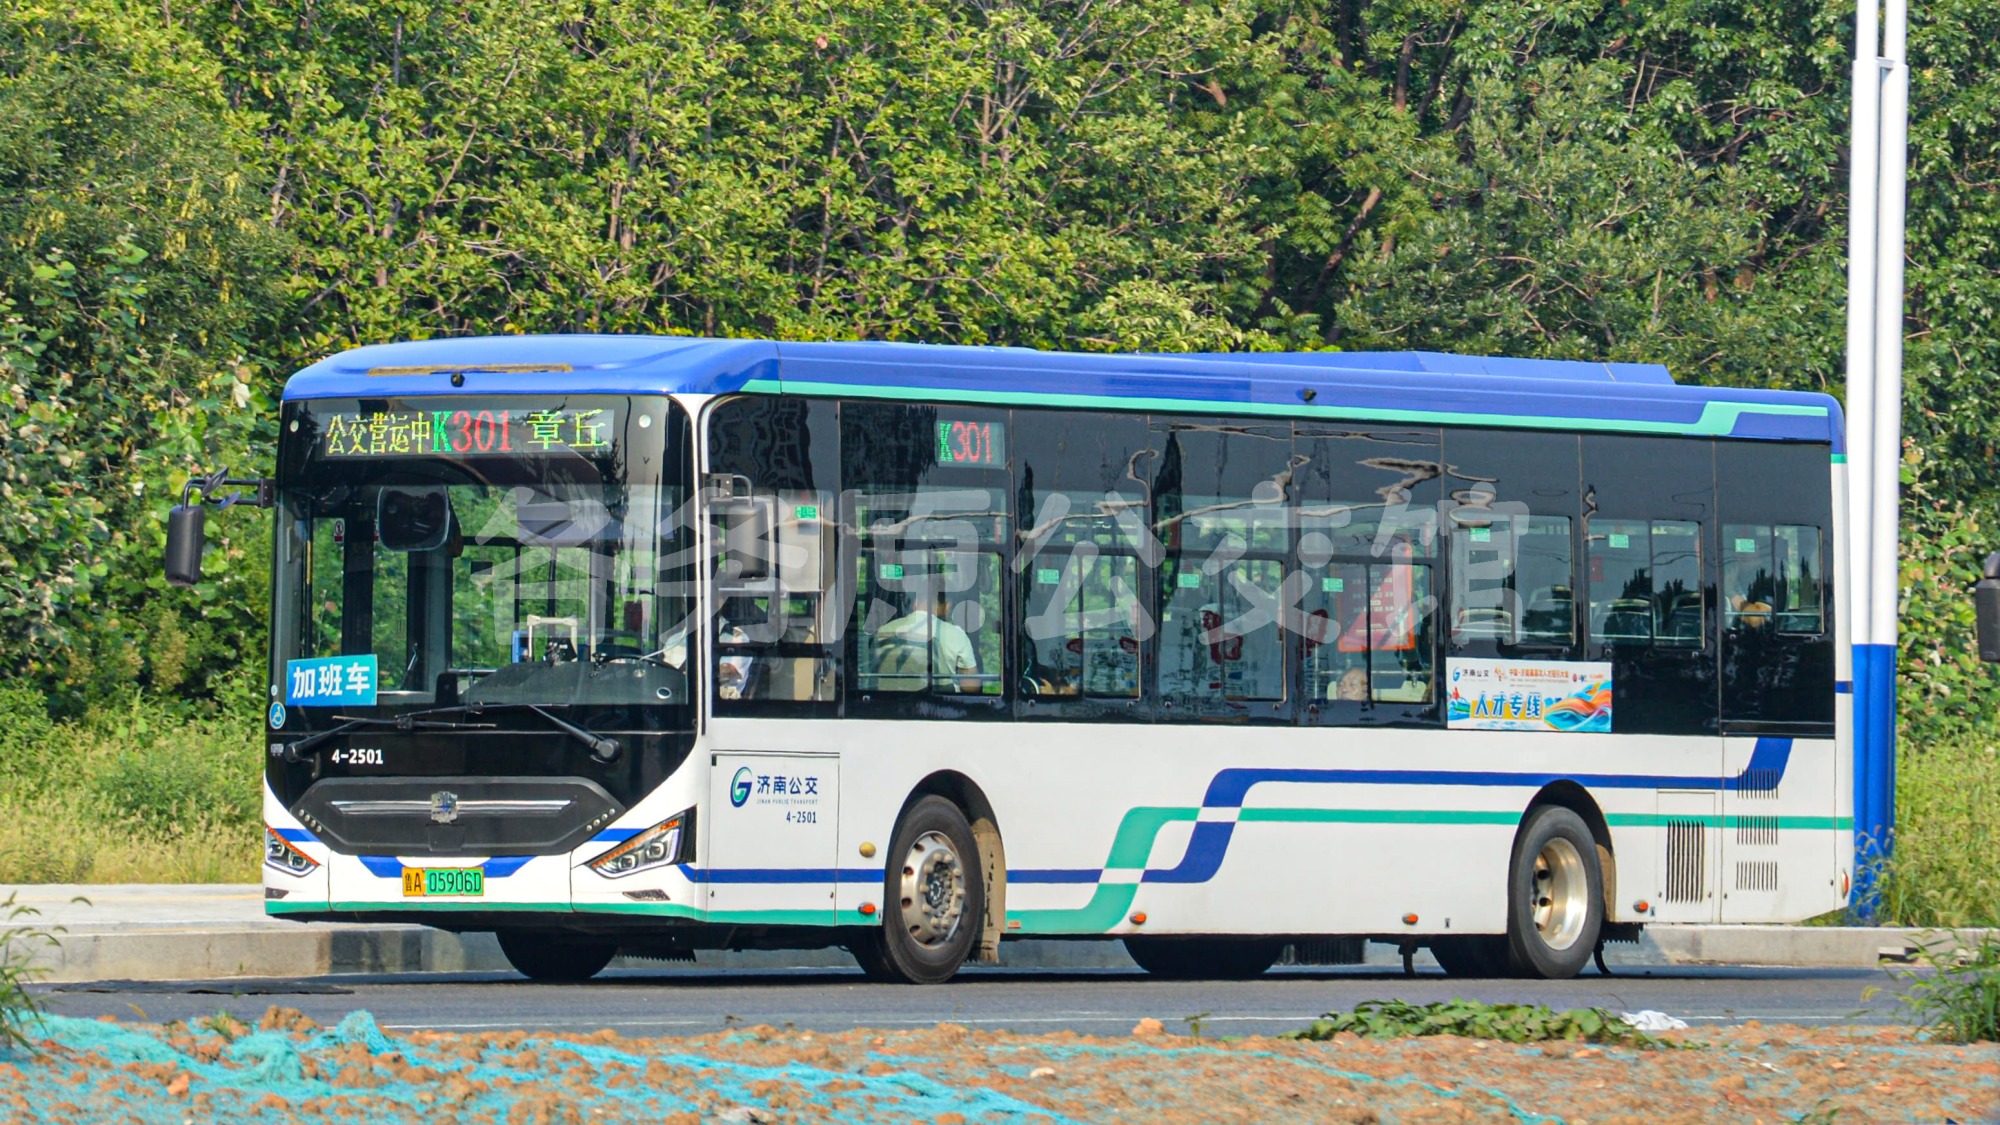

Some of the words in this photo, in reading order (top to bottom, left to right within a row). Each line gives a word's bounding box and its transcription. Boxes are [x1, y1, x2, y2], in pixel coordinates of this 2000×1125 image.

[527, 408, 609, 450] 章丘
[939, 421, 992, 464] K301
[292, 662, 370, 699] 加班车
[1475, 693, 1541, 717] 人才专线
[331, 748, 384, 764] 4-2501
[757, 775, 818, 795] 济南公交
[786, 811, 817, 824] 4-2501
